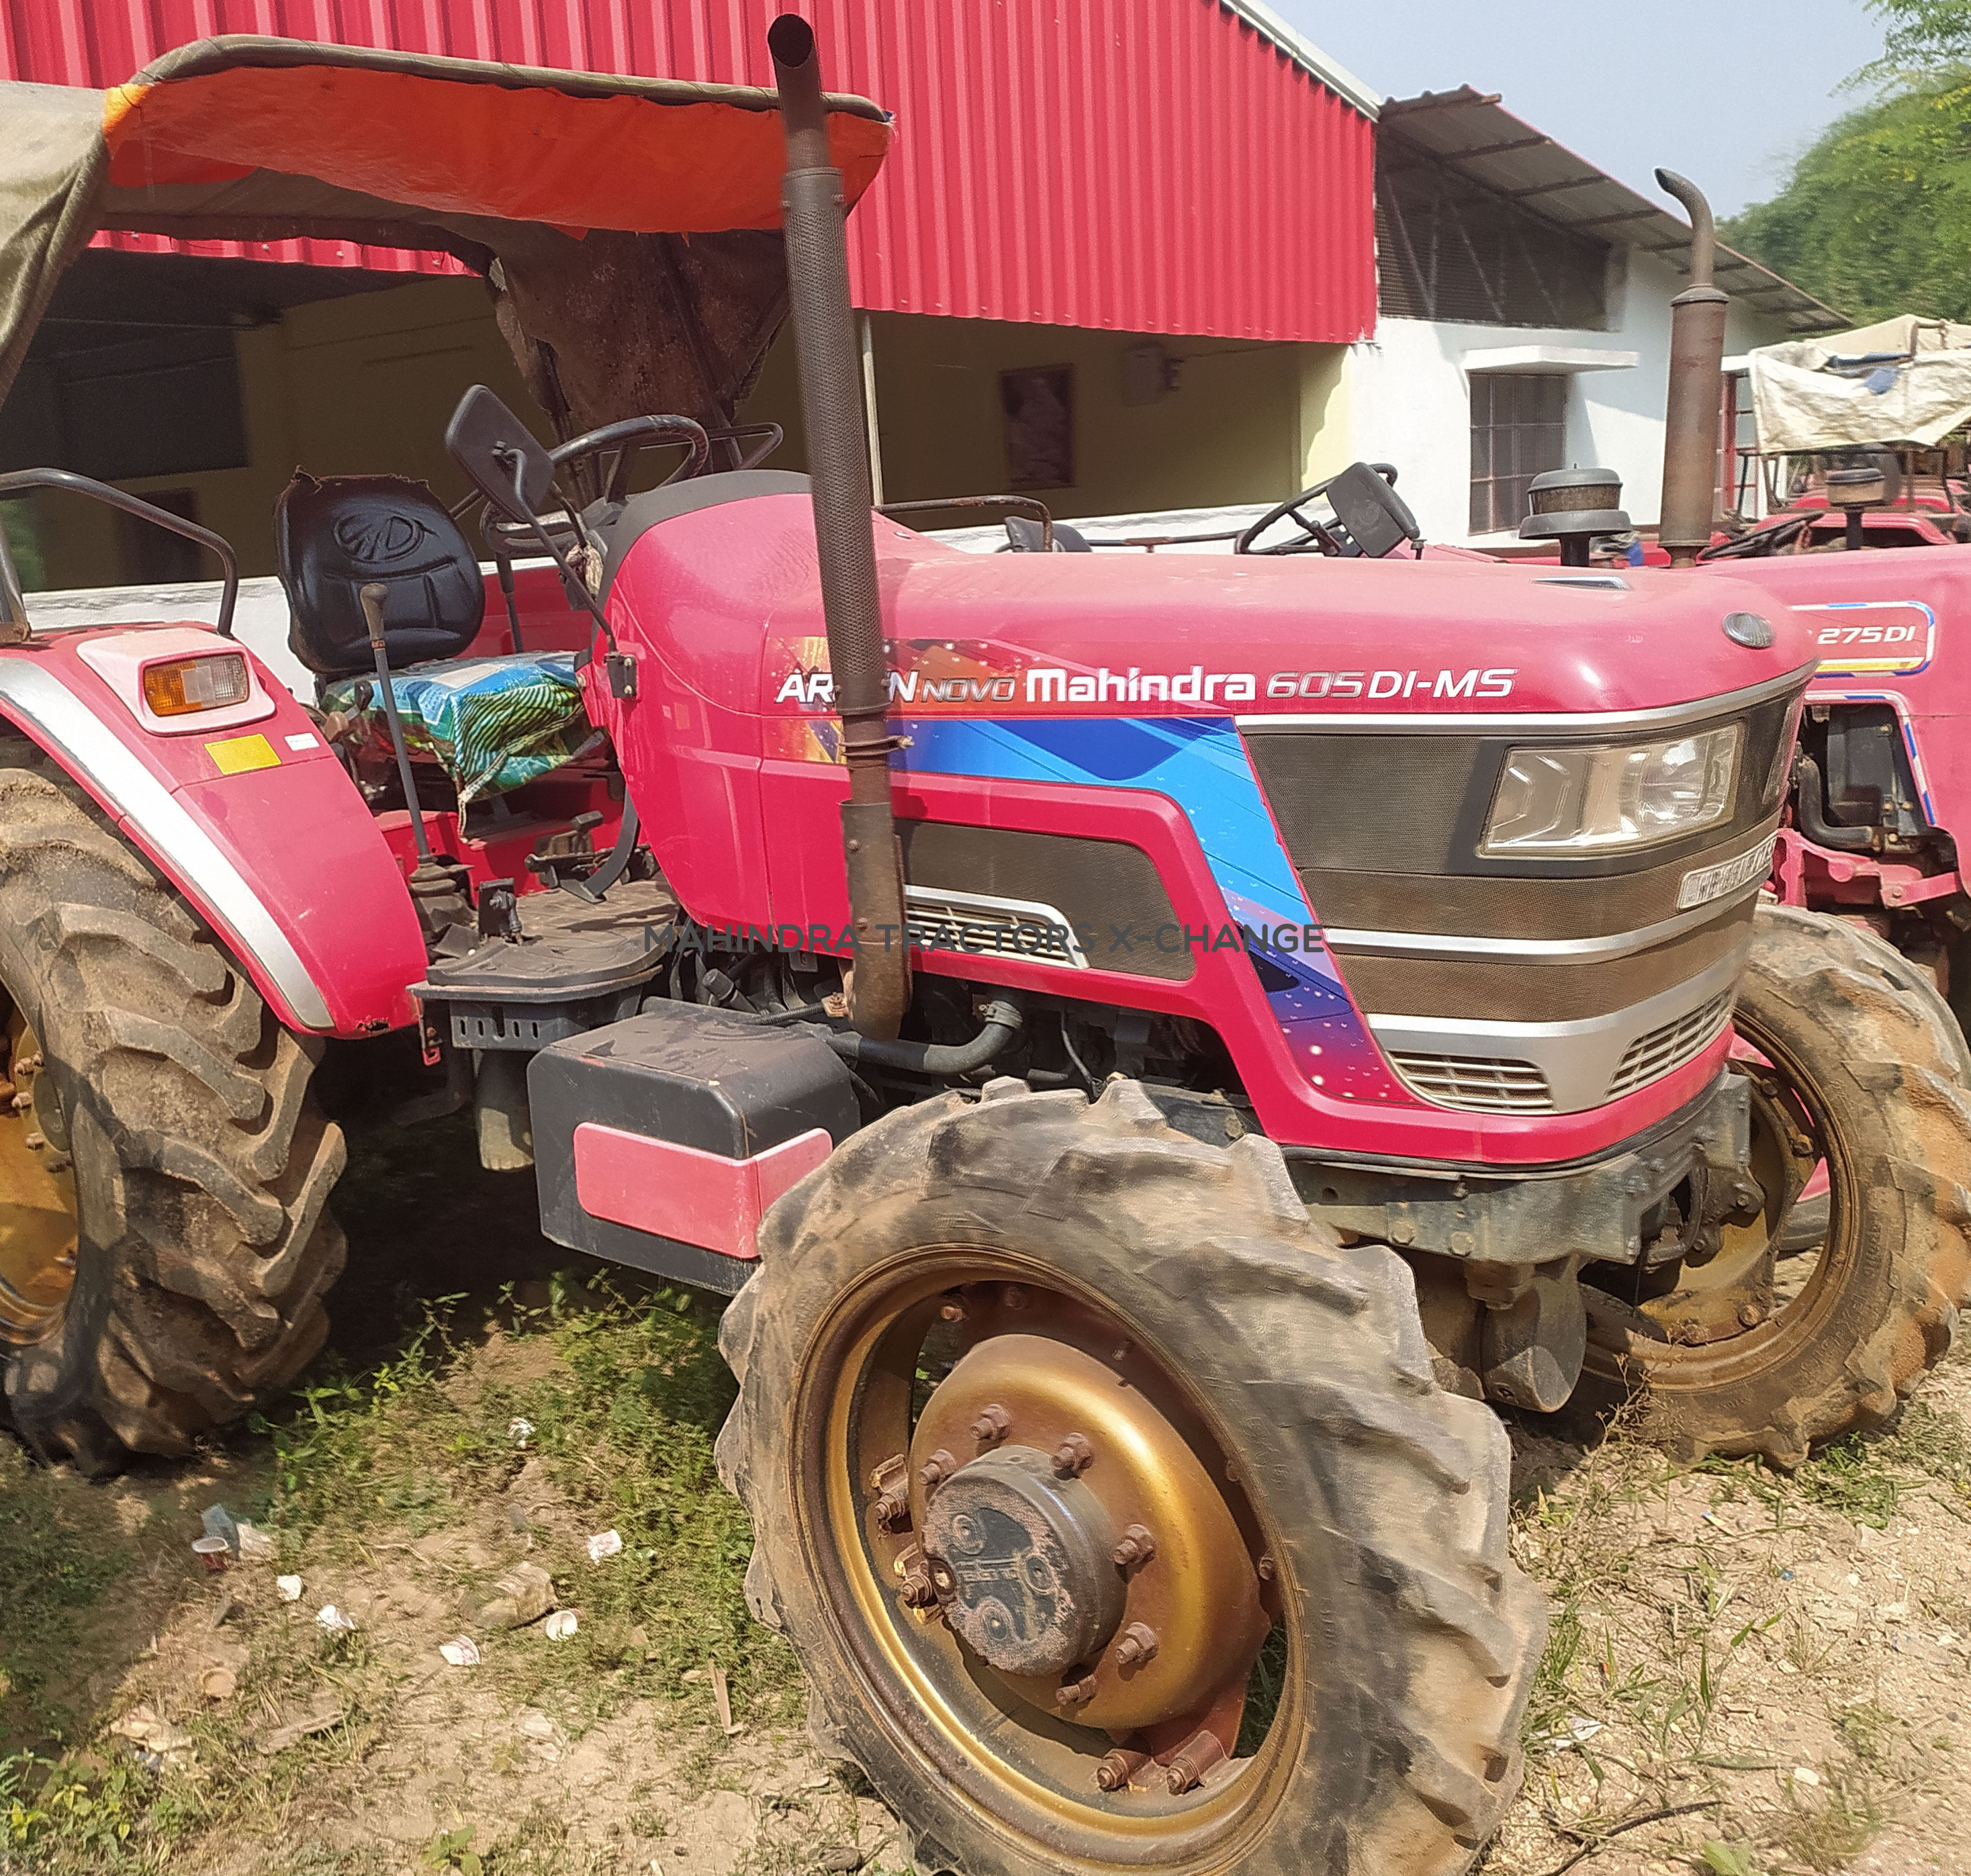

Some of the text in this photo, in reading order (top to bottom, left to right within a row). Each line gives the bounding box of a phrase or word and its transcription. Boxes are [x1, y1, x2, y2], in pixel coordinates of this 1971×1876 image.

[1817, 625, 1917, 645] 275DI
[774, 666, 1518, 704] ARN NOVO Mahindra 605 DI-MS
